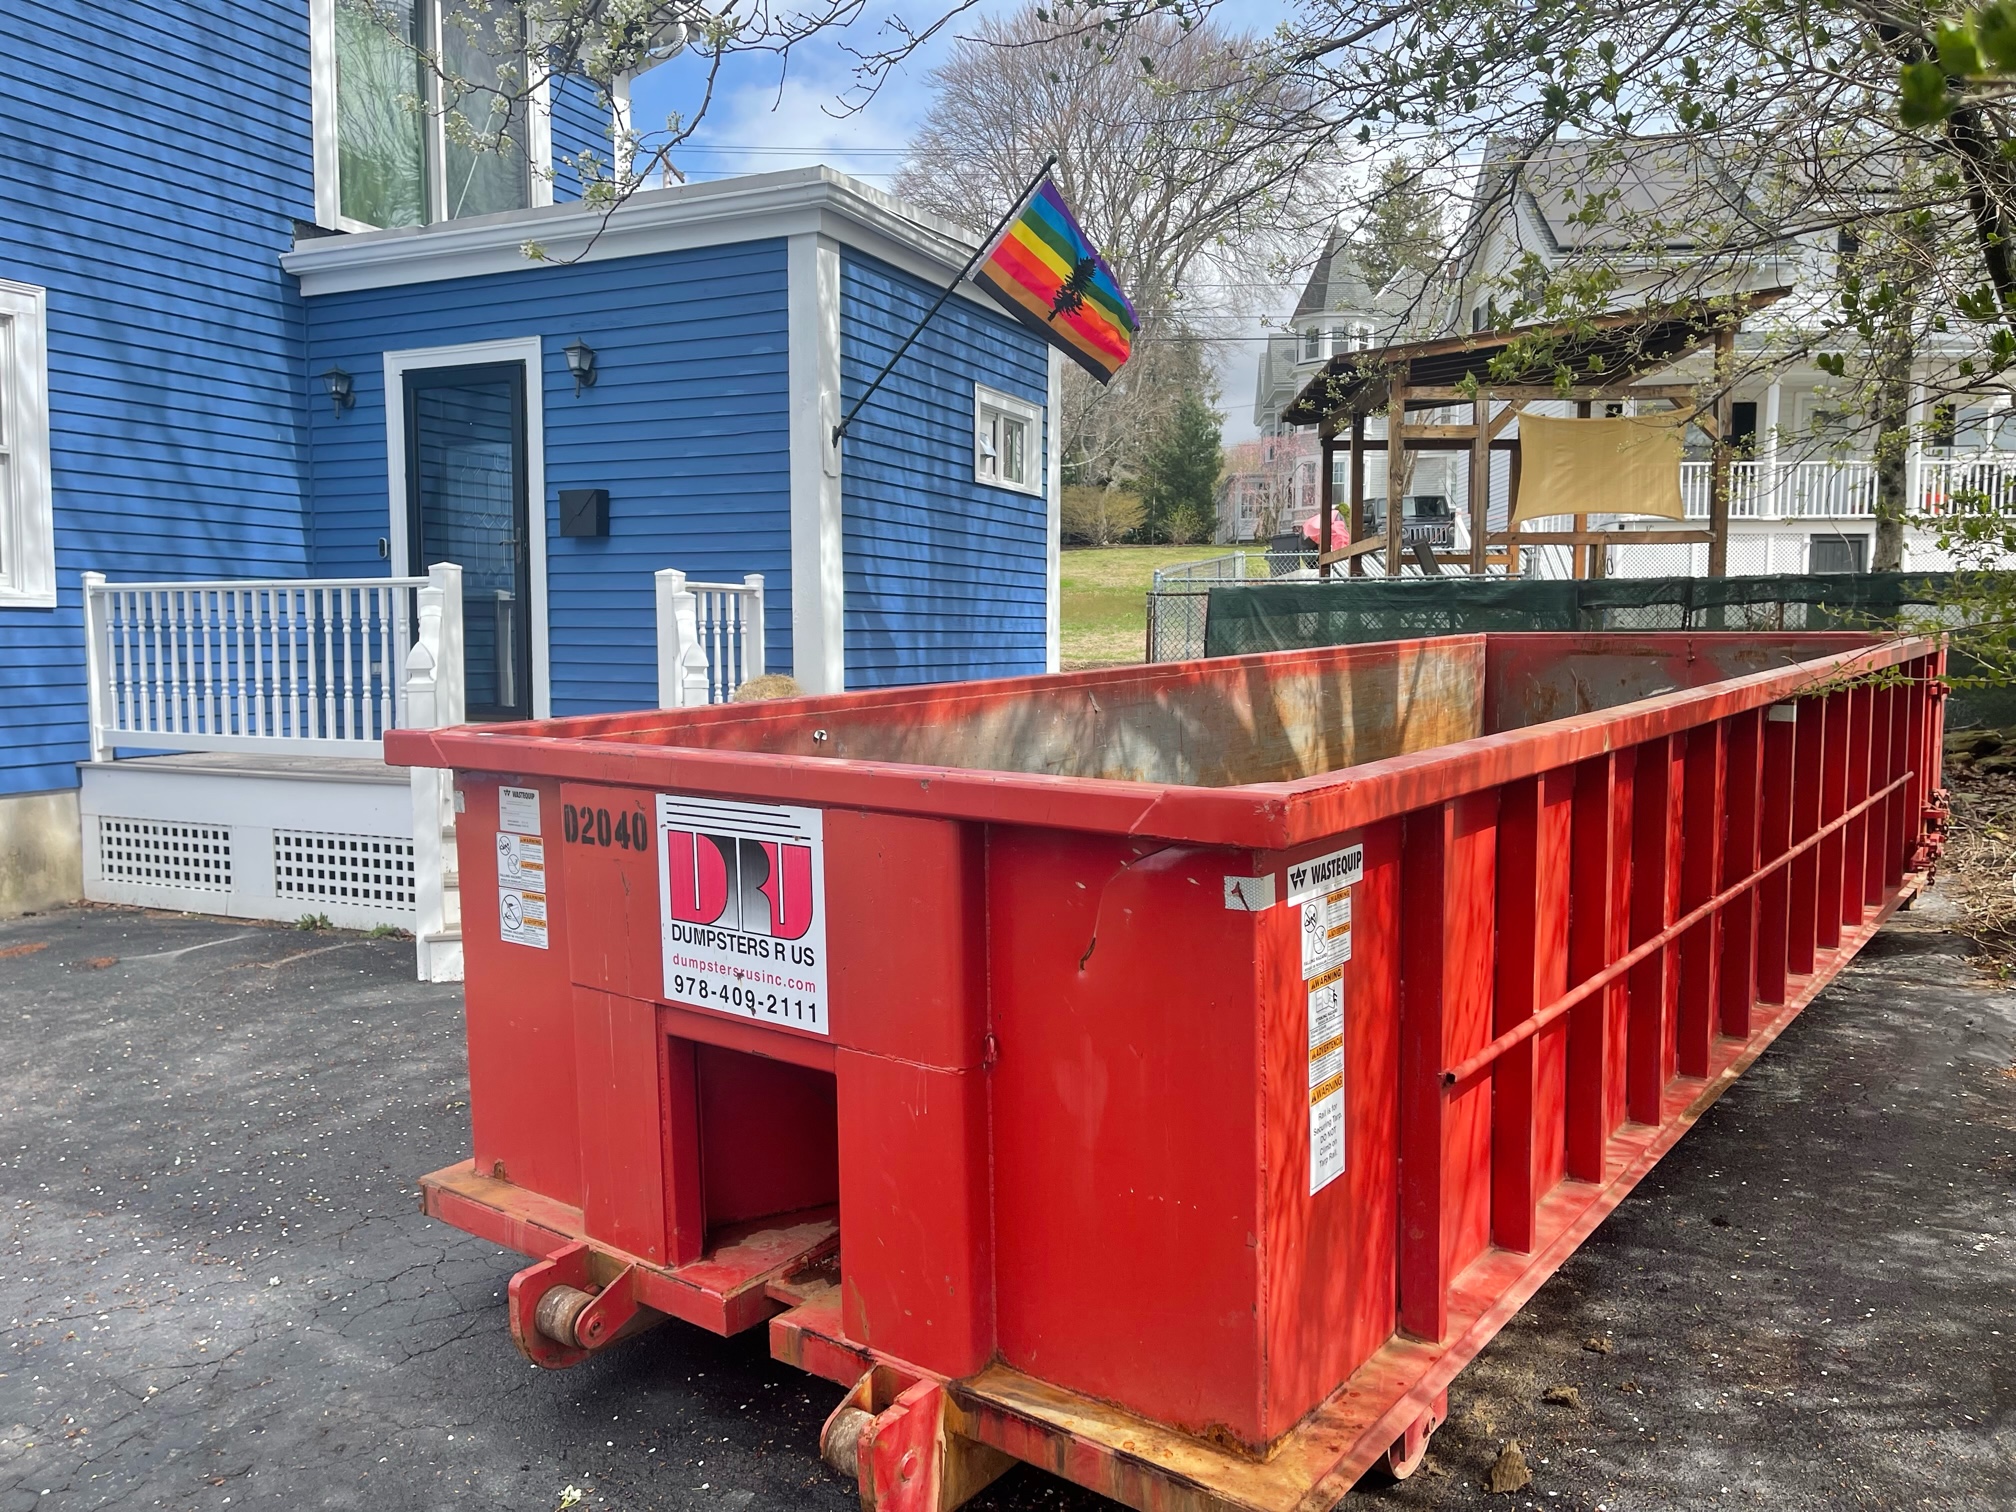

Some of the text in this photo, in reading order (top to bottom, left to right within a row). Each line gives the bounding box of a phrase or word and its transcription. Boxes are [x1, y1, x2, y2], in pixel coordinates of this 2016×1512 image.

[563, 804, 648, 852] D2040
[1311, 851, 1362, 885] WASTEQUIP
[671, 924, 815, 967] DUMPSTERS R US
[673, 953, 816, 993] dumpstersrusinc.com
[1315, 969, 1342, 987] WARNING
[674, 974, 816, 1023] 978-409-2111
[1316, 1036, 1343, 1056] ADVERTENCIA
[1316, 1076, 1343, 1100] WARNING
[1320, 1125, 1337, 1144] DO NOT
